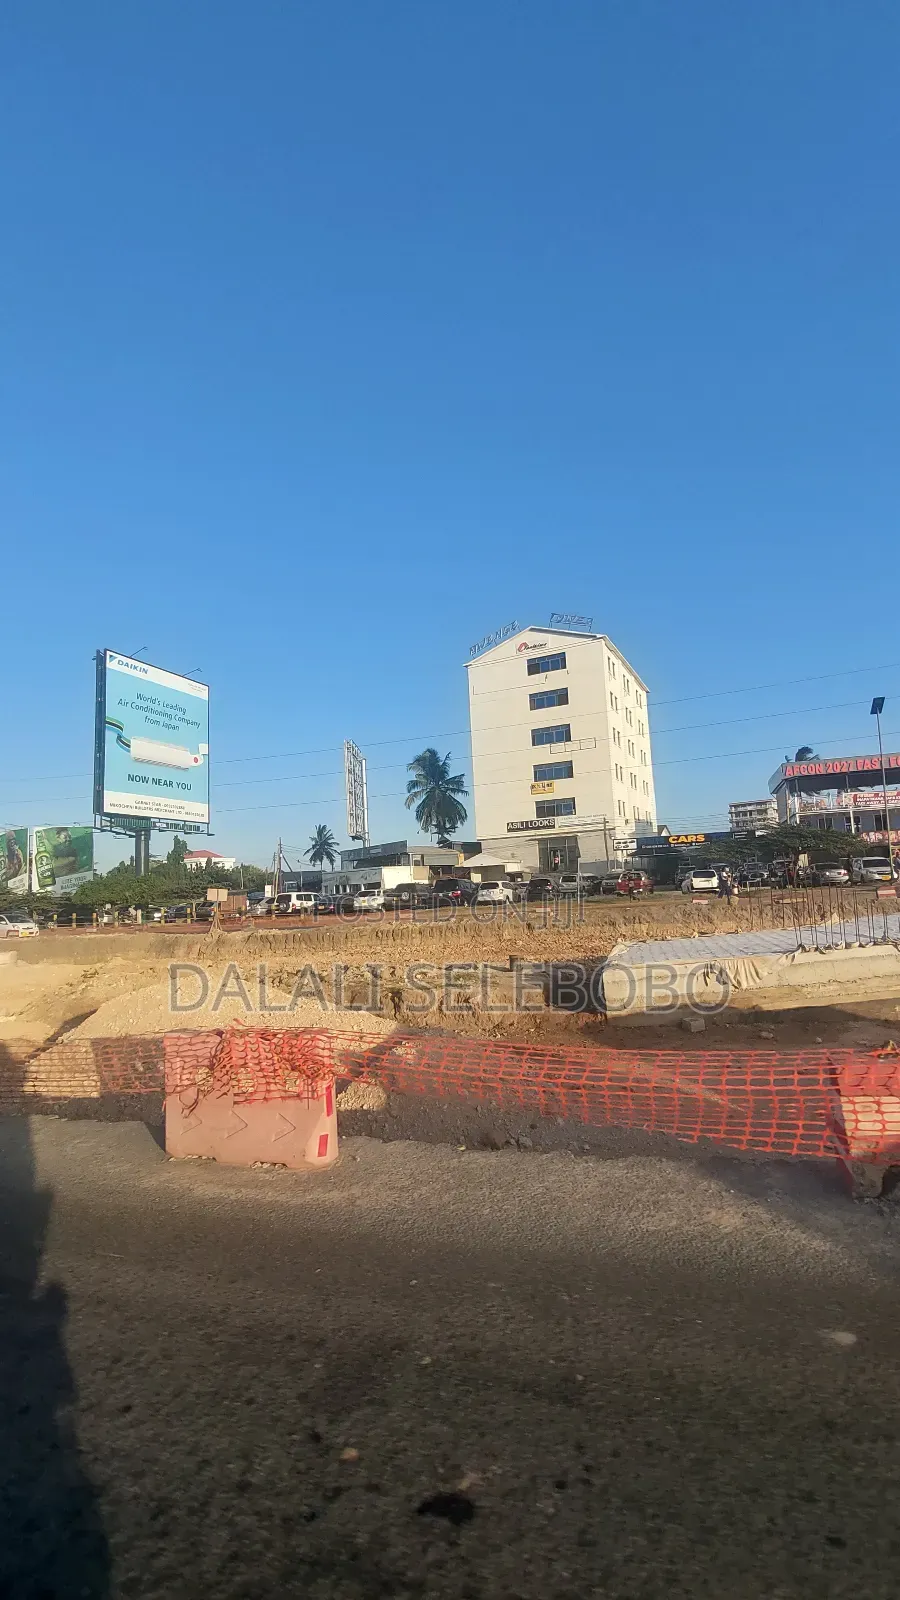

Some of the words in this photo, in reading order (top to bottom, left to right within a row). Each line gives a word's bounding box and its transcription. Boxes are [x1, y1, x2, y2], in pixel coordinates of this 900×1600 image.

[117, 659, 149, 675] DAIKIN
[136, 692, 161, 706] World's
[162, 701, 187, 715] Leading
[117, 698, 129, 708] Air
[130, 702, 173, 720] Conditioning
[173, 715, 201, 729] Company
[144, 716, 160, 726] from
[162, 721, 180, 732] Japan
[785, 763, 824, 777] AFCON
[127, 773, 150, 784] NOW
[151, 777, 174, 788] NEAR
[176, 781, 192, 791] YOU
[507, 821, 526, 830] ASILI
[528, 819, 555, 828] LOOKS
[668, 834, 705, 843] CARS
